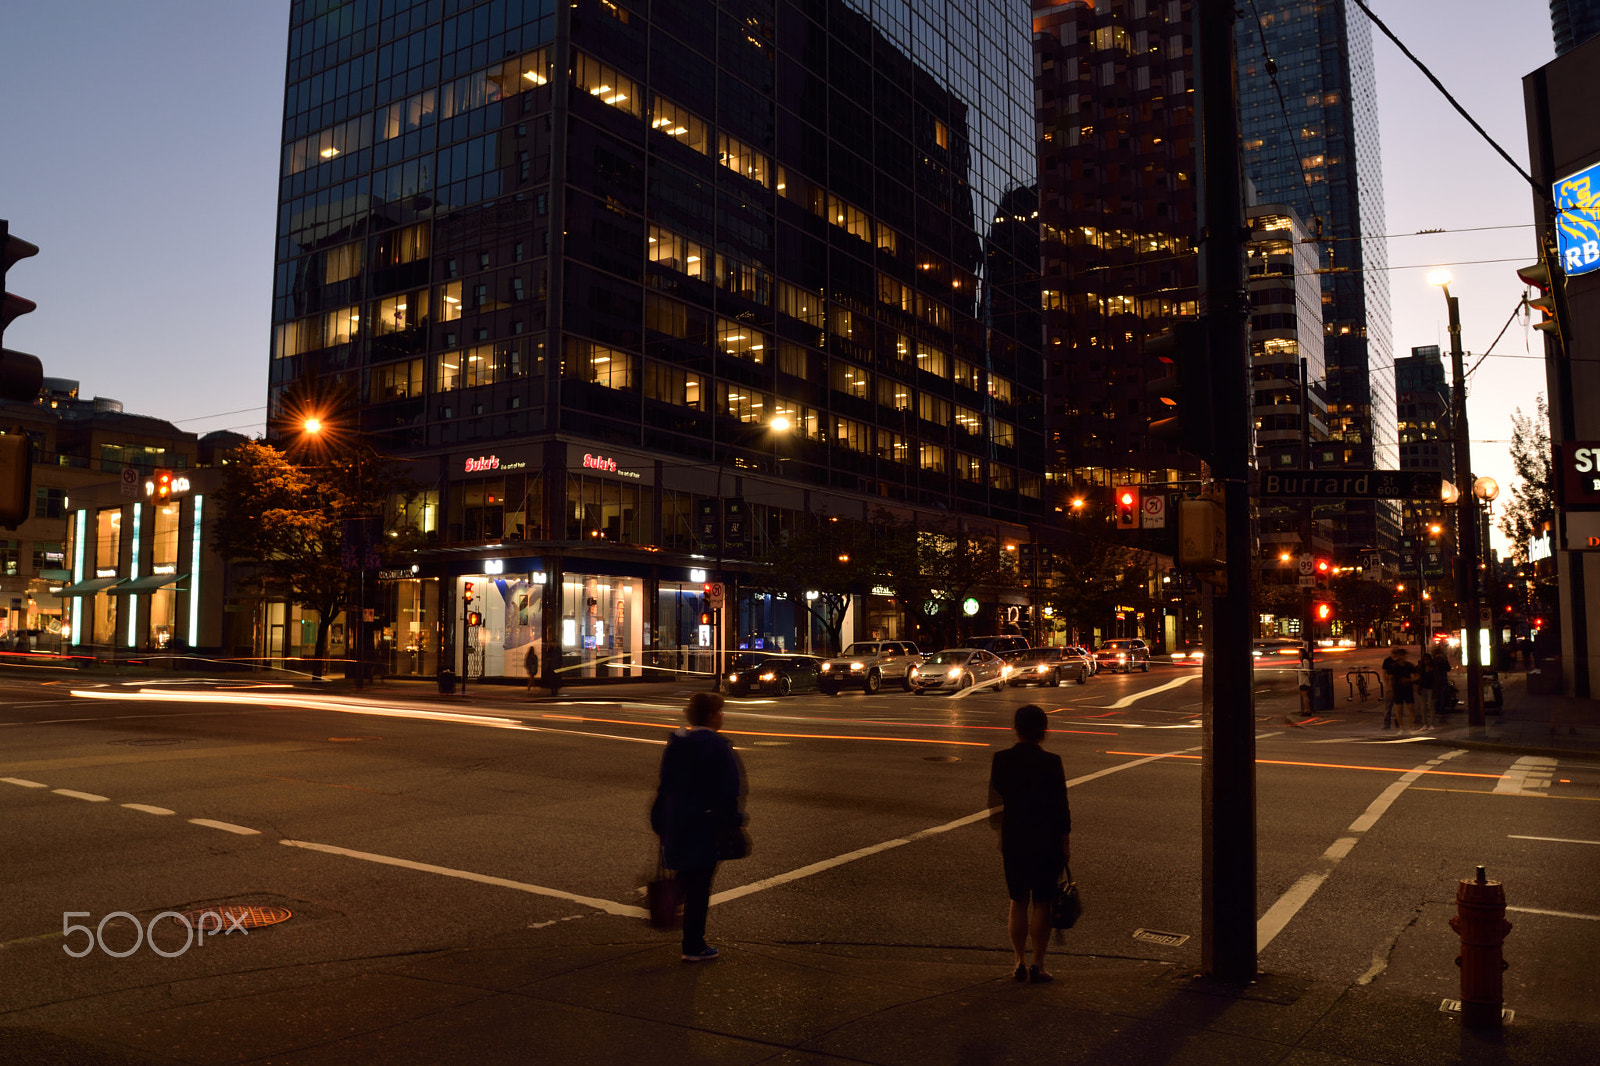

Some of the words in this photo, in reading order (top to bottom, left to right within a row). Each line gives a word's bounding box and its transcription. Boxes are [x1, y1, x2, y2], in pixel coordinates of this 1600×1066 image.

[464, 455, 500, 473] Suki's
[582, 453, 617, 472] Suki's
[1266, 474, 1369, 495] Burrard
[1383, 475, 1395, 487] St
[1377, 486, 1400, 496] 600
[1300, 561, 1313, 571] 99
